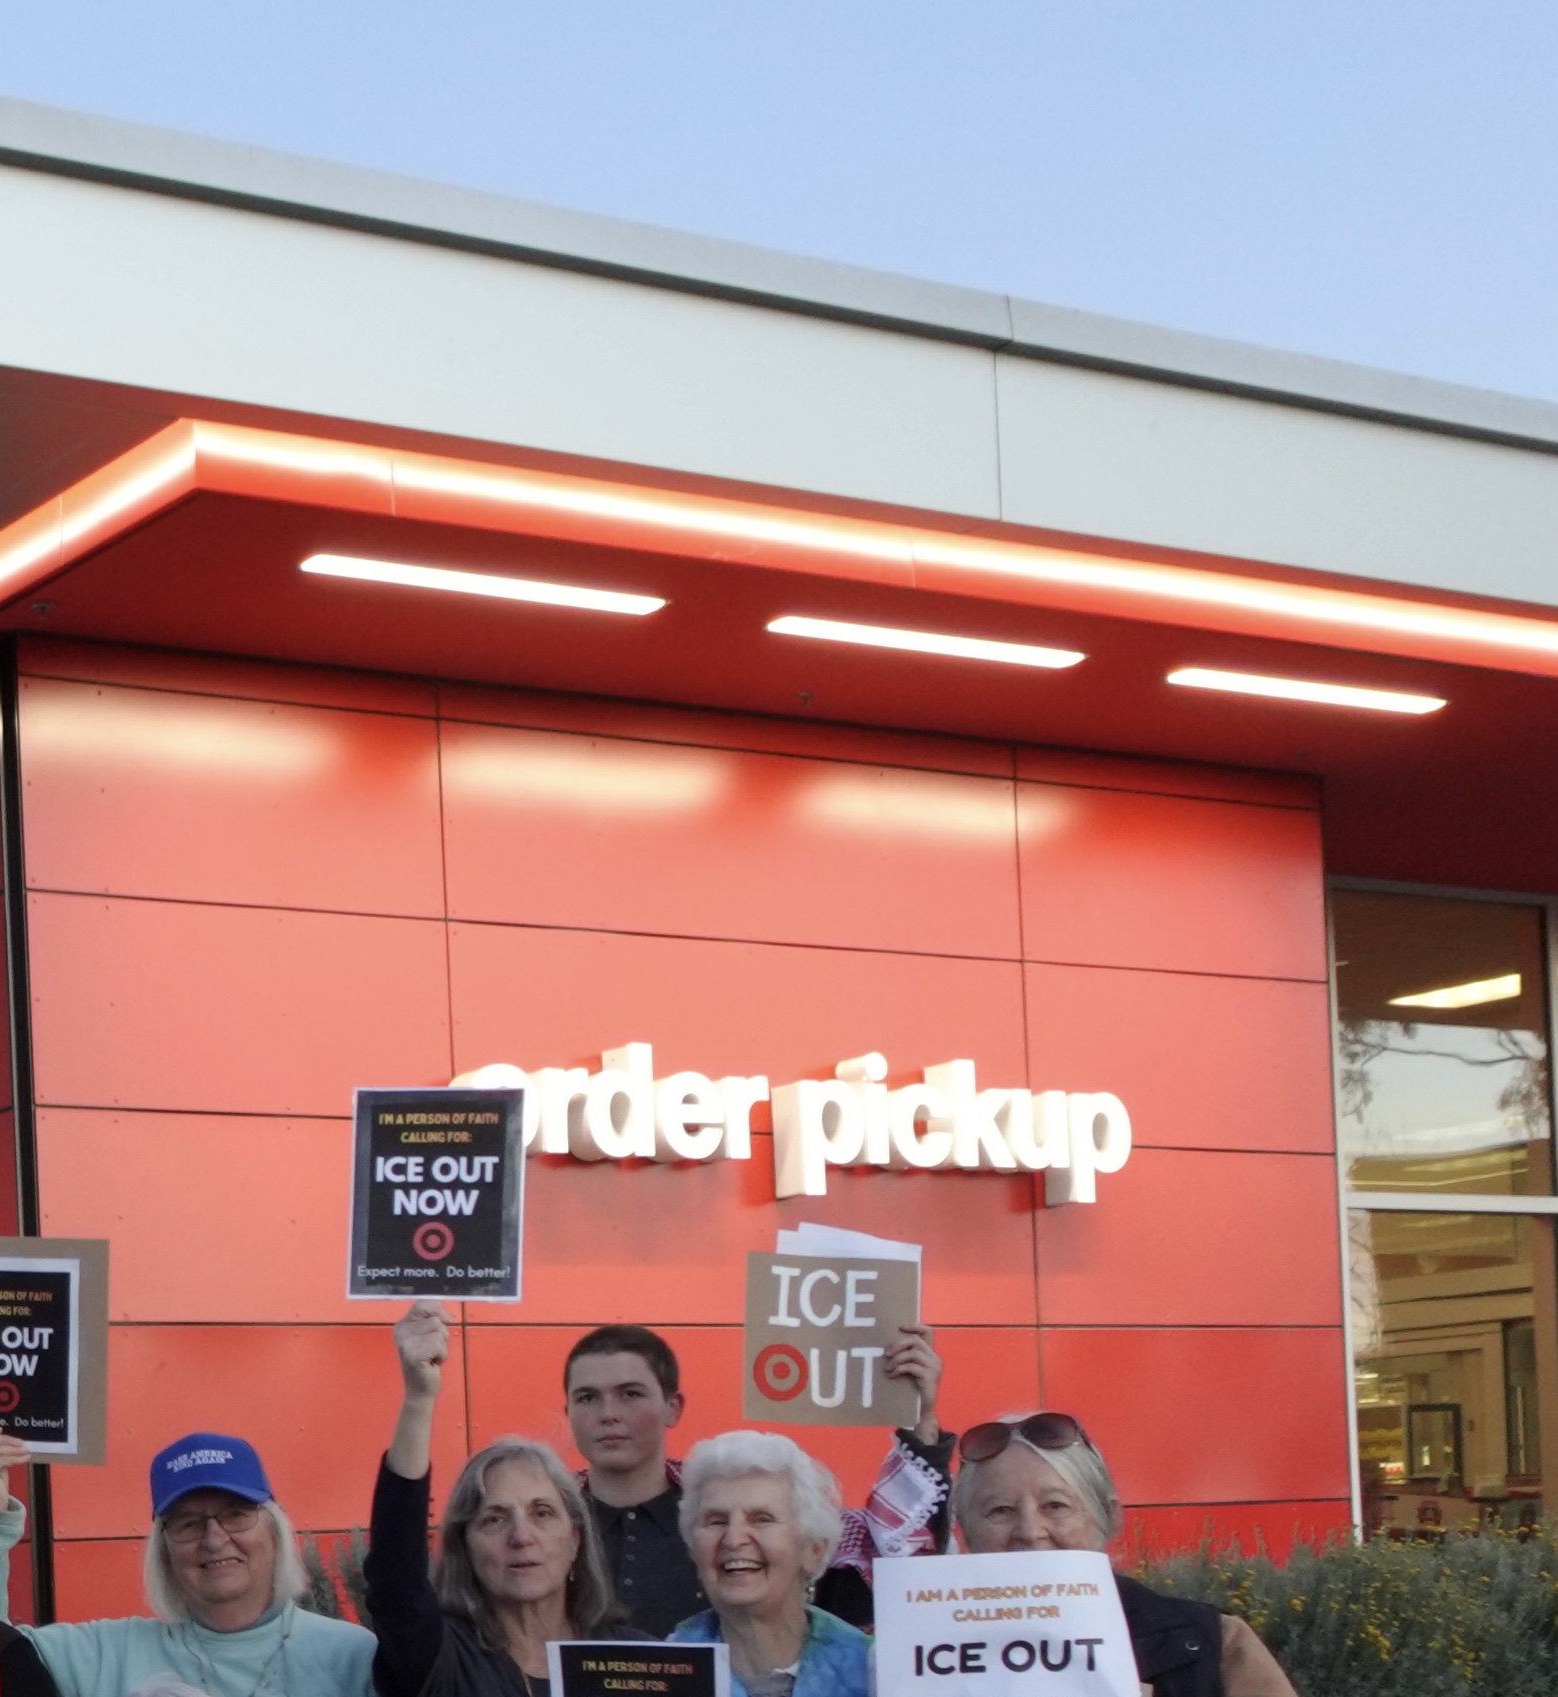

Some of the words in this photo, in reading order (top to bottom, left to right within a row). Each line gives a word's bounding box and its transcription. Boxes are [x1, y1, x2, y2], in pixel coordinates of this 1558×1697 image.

[395, 1113, 405, 1125] A
[405, 1113, 450, 1125] PERSON
[452, 1113, 465, 1124] OF
[468, 1112, 499, 1124] FAITH
[772, 1052, 1132, 1206] pickup
[400, 1131, 445, 1143] CALLING
[375, 1156, 424, 1183] ICE
[431, 1156, 499, 1183] OUT
[393, 1189, 479, 1216] NOW
[357, 1265, 400, 1279] Expect
[446, 1266, 464, 1278] Do
[467, 1265, 510, 1279] better!
[16, 1291, 27, 1300] OF
[28, 1291, 53, 1301] FAITH
[768, 1264, 879, 1328] ICE
[1, 1326, 54, 1350] OUT
[14, 1416, 29, 1427] Do
[31, 1416, 64, 1429] better!
[190, 1449, 233, 1459] AMERICA
[194, 1457, 226, 1466] AGAIN
[914, 1589, 943, 1603] AM
[946, 1588, 959, 1602] A
[962, 1585, 1028, 1602] PERSON
[1031, 1585, 1053, 1598] OF
[1056, 1583, 1099, 1597] FAITH
[952, 1607, 1023, 1623] CALLING
[1026, 1605, 1061, 1619] FOR
[914, 1642, 987, 1676] ICE
[1001, 1638, 1104, 1673] OUT
[598, 1661, 607, 1671] A
[607, 1661, 647, 1673] PERSON
[649, 1663, 662, 1673] OF
[664, 1664, 694, 1675] FAITH
[604, 1678, 644, 1690] CALLING
